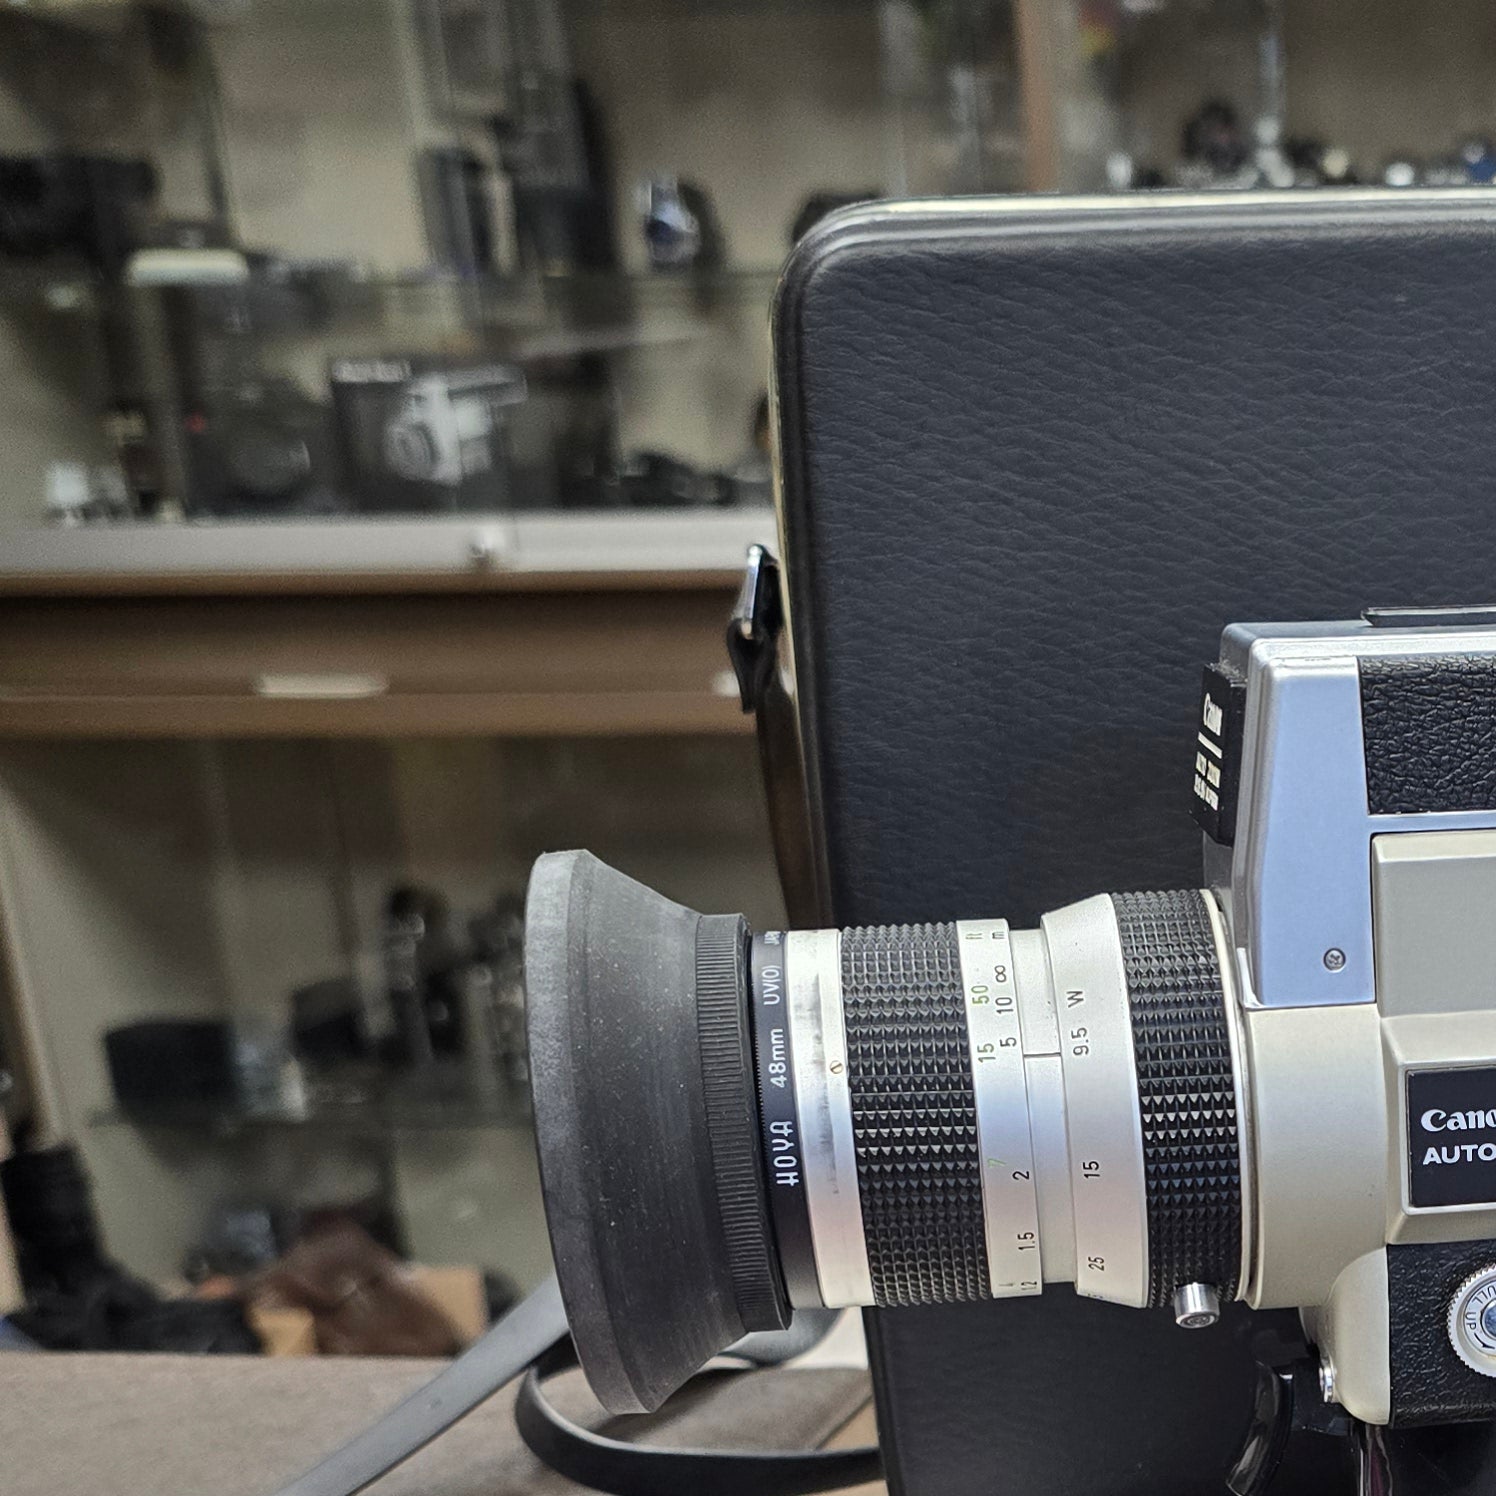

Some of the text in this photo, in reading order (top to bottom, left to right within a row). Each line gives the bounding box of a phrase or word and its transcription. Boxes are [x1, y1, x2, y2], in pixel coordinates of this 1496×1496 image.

[971, 985, 989, 1004] 50
[1066, 990, 1084, 1008] W
[995, 997, 1013, 1014] 10
[1000, 1037, 1017, 1047] 5
[1071, 1027, 1089, 1056] 9.5
[769, 1028, 787, 1088] 48mm
[977, 1043, 996, 1063] 15
[770, 1121, 799, 1186] HOYA
[1012, 1171, 1029, 1180] 2
[1083, 1161, 1100, 1179] 15
[1018, 1231, 1035, 1250] 1.5
[1088, 1256, 1105, 1271] 25
[1465, 1312, 1477, 1330] UP
